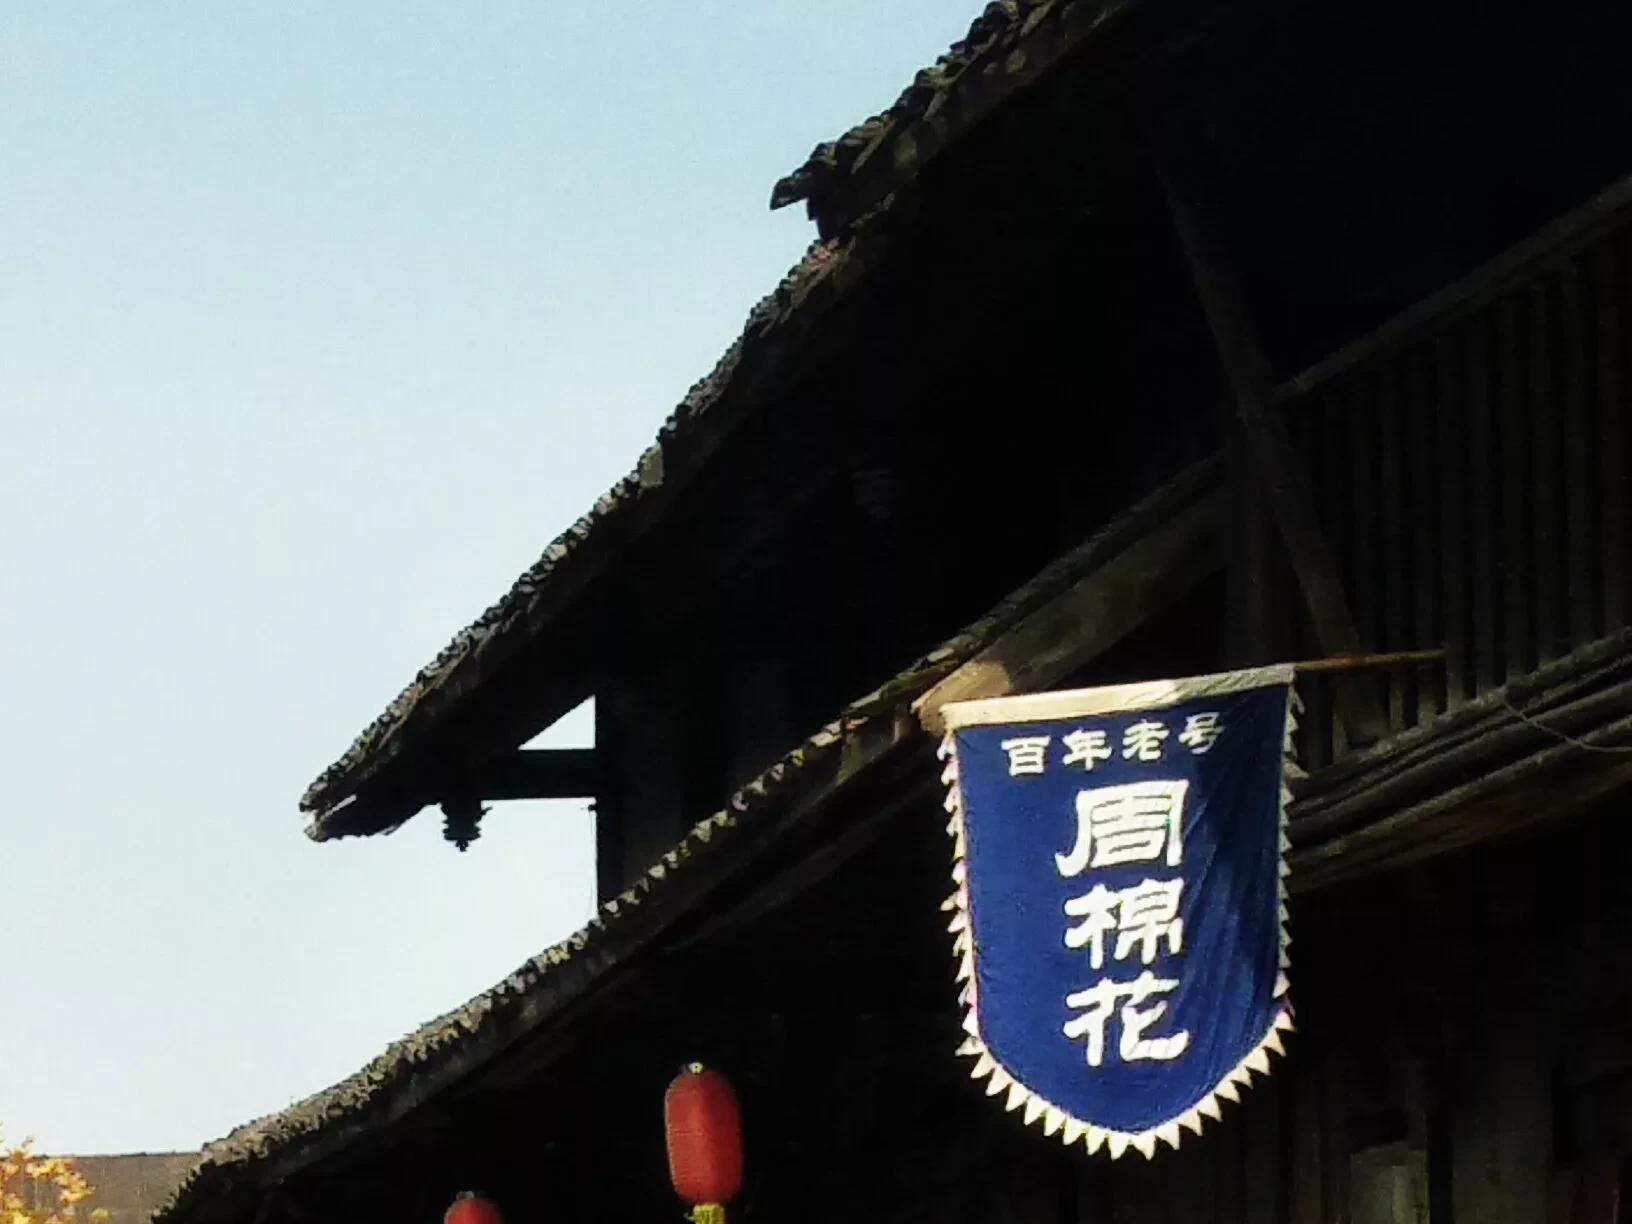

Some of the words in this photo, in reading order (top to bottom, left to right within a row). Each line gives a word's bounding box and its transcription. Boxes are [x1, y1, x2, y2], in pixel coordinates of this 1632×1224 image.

[1000, 711, 1225, 778] 百年老号
[1055, 778, 1190, 1068] 周棉花
